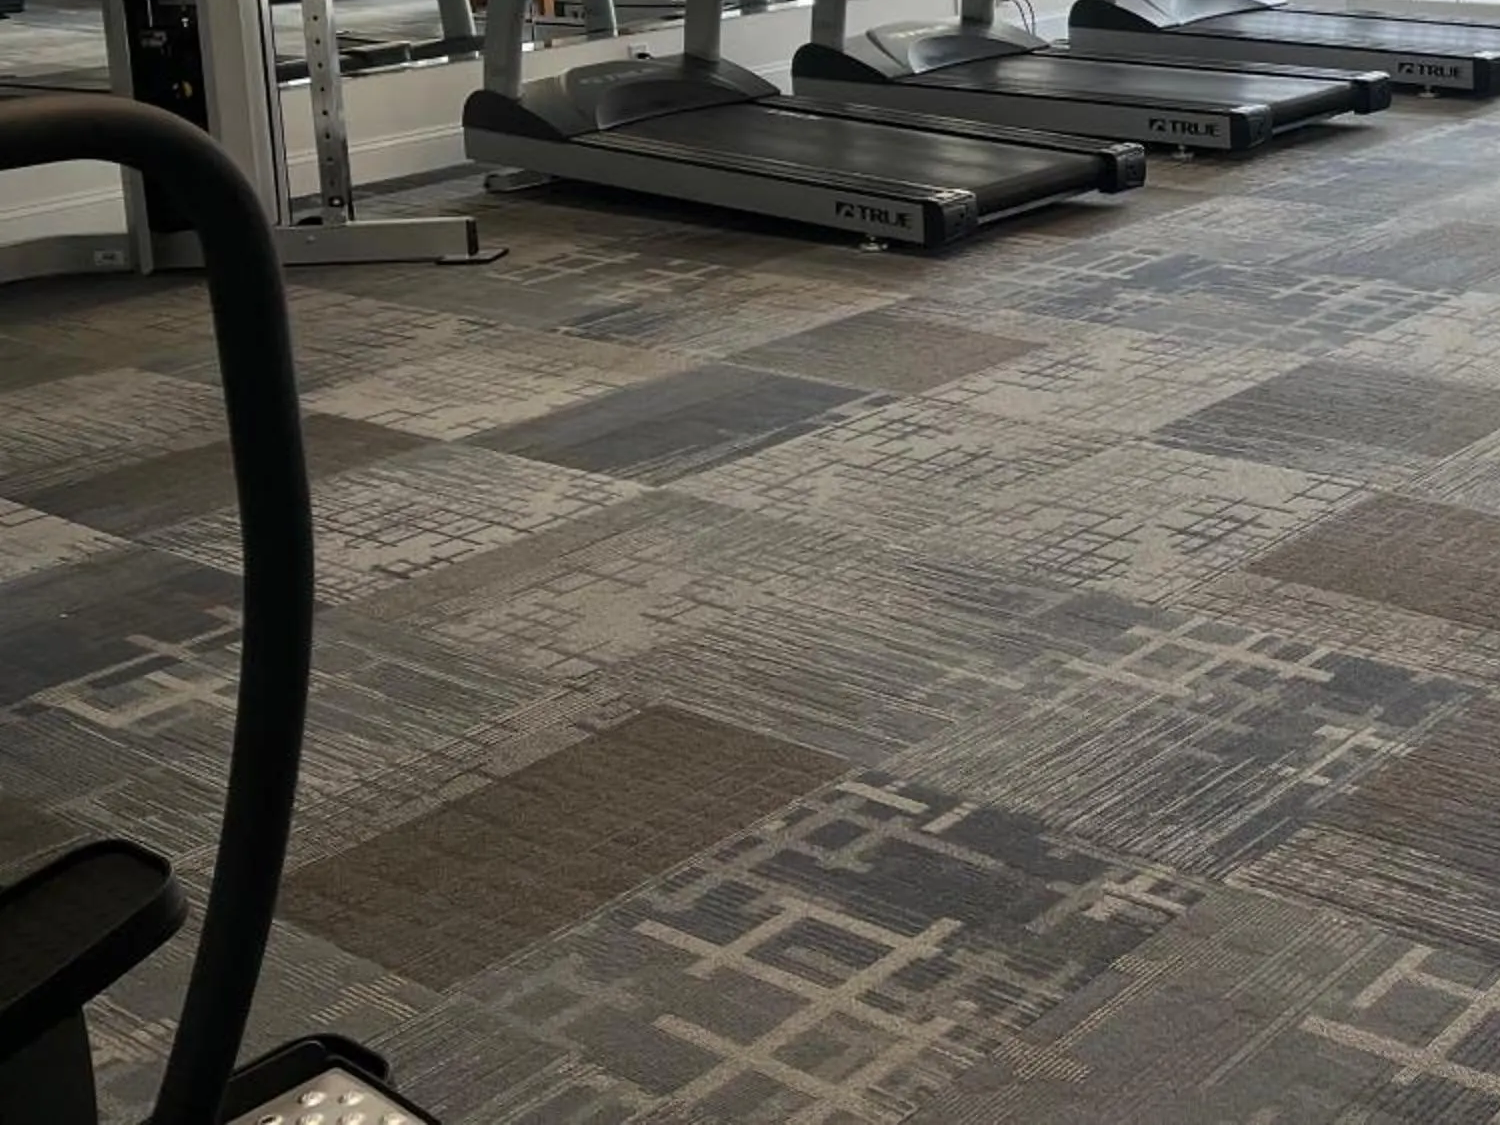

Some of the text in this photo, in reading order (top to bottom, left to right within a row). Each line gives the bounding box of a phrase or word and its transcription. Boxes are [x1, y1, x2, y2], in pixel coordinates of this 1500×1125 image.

[1417, 62, 1461, 78] TRUE
[1169, 120, 1221, 138] TRUE
[857, 204, 913, 229] TRUE
